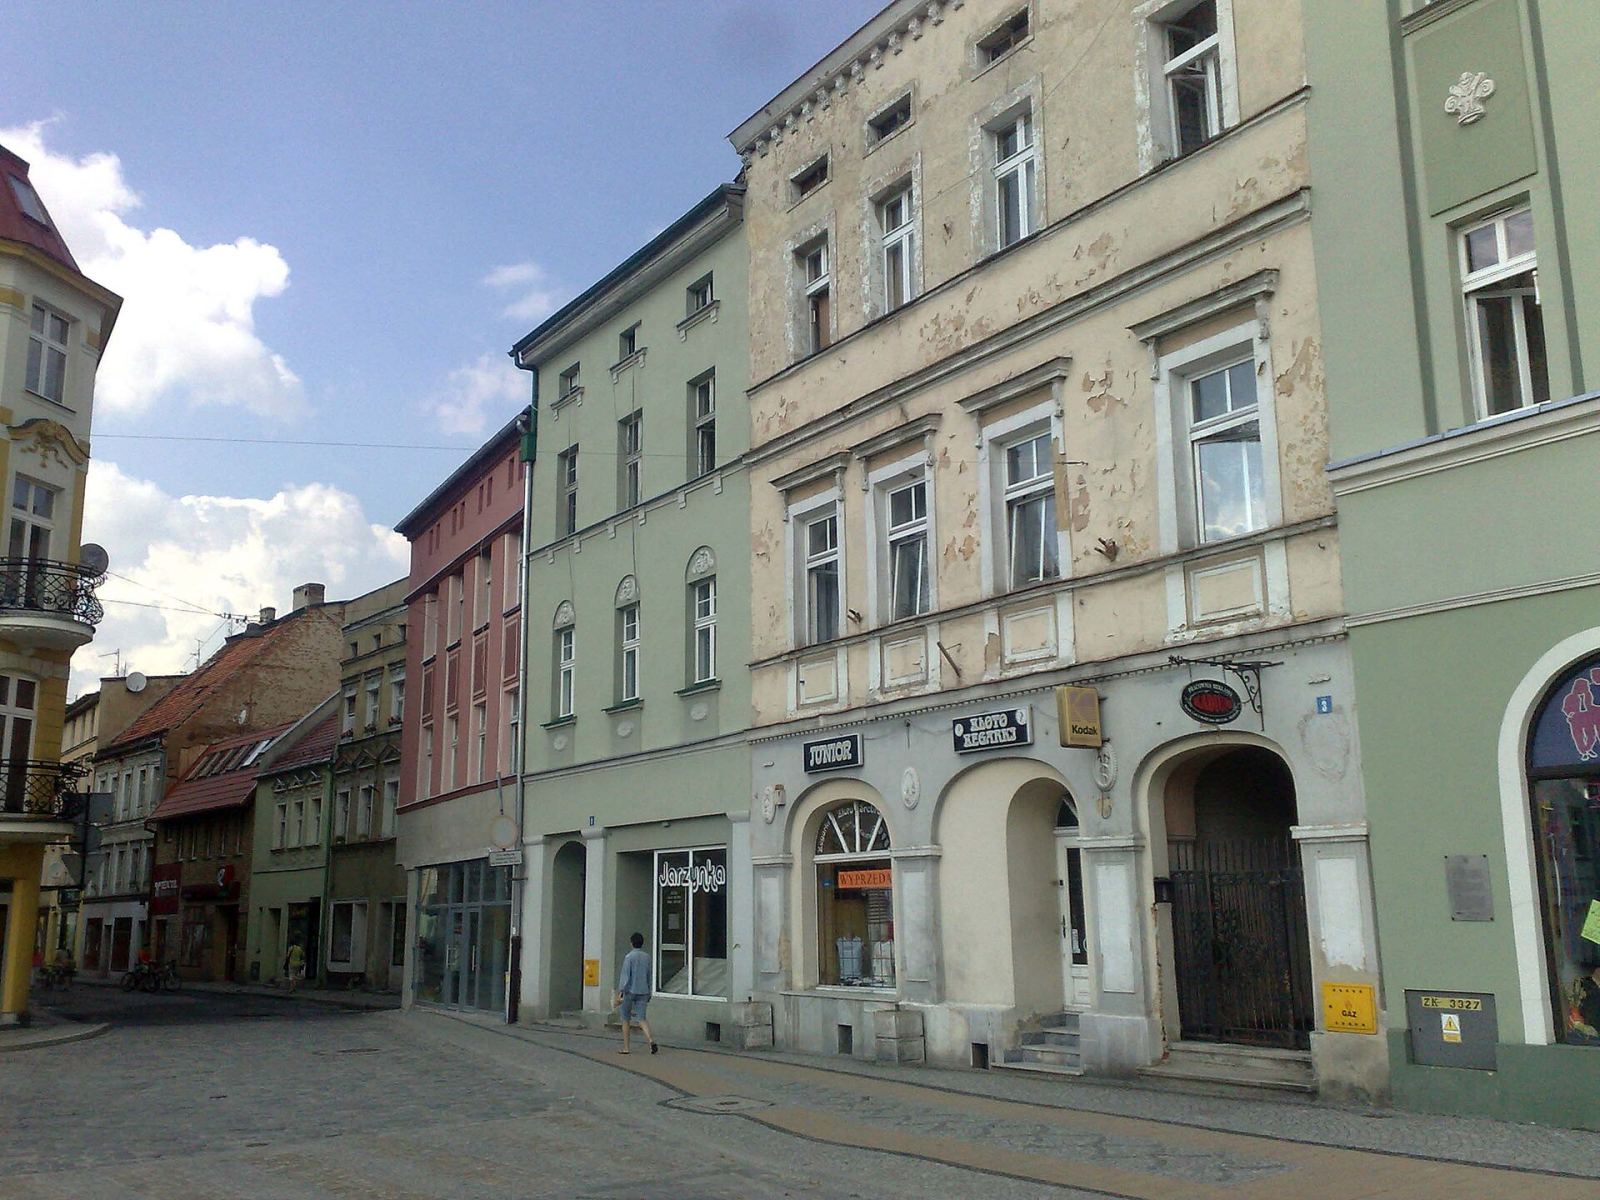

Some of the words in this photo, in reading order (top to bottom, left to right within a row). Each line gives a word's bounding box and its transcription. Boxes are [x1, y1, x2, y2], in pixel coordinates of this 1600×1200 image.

[1072, 724, 1098, 735] Kodak
[810, 740, 852, 767] JUNIOR
[659, 858, 726, 893] Jarzynka
[1449, 999, 1480, 1010] 3327
[1341, 1010, 1357, 1018] GAZ
